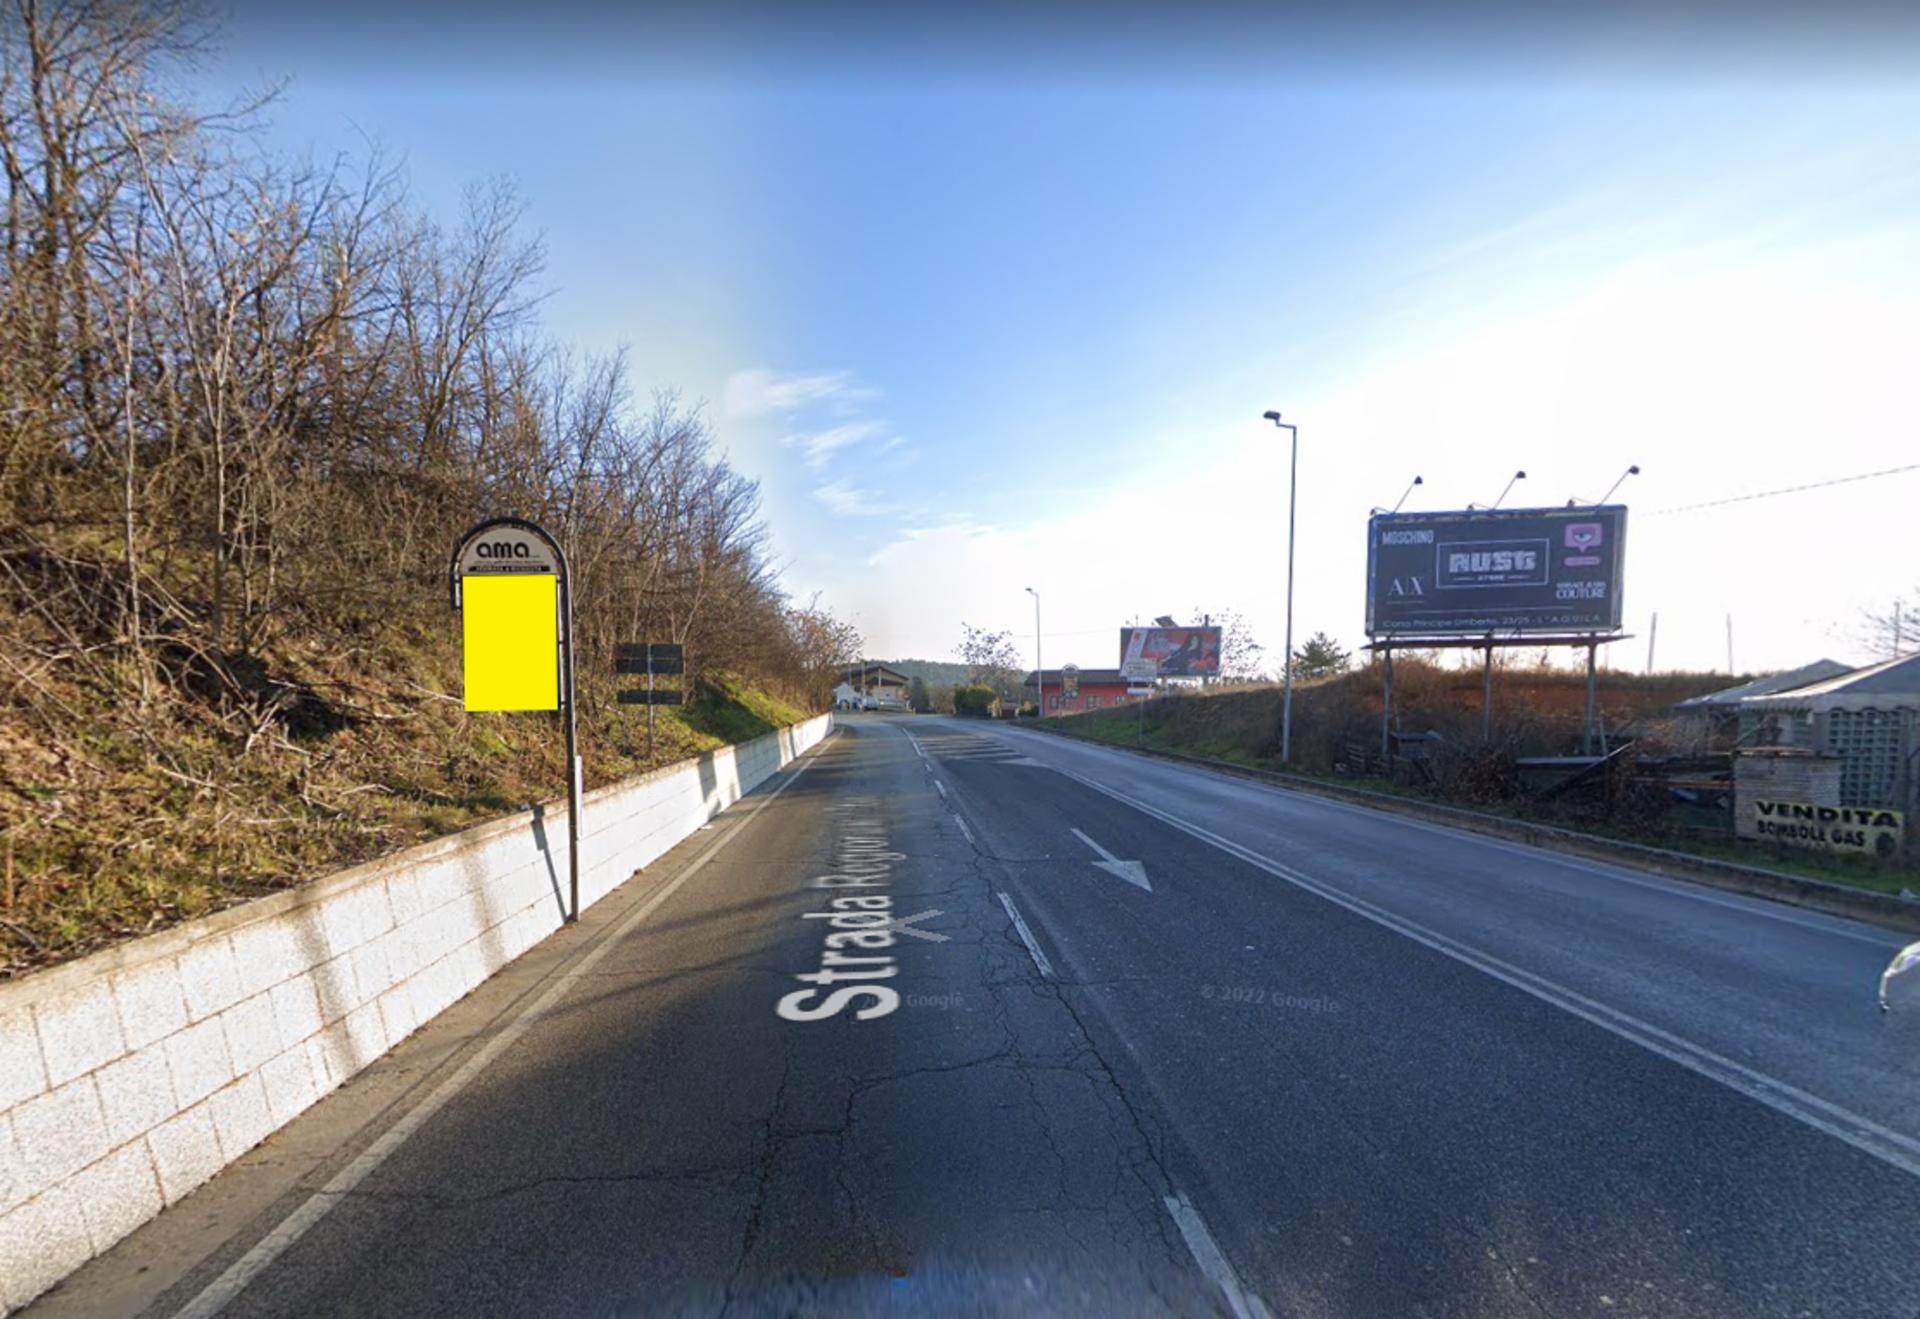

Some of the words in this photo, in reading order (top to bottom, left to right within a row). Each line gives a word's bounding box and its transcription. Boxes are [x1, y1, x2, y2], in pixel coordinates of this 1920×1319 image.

[1382, 530, 1434, 545] MOSCHINO
[476, 542, 530, 558] ama
[1756, 801, 1898, 828] VENDITA
[1832, 829, 1865, 847] GAS
